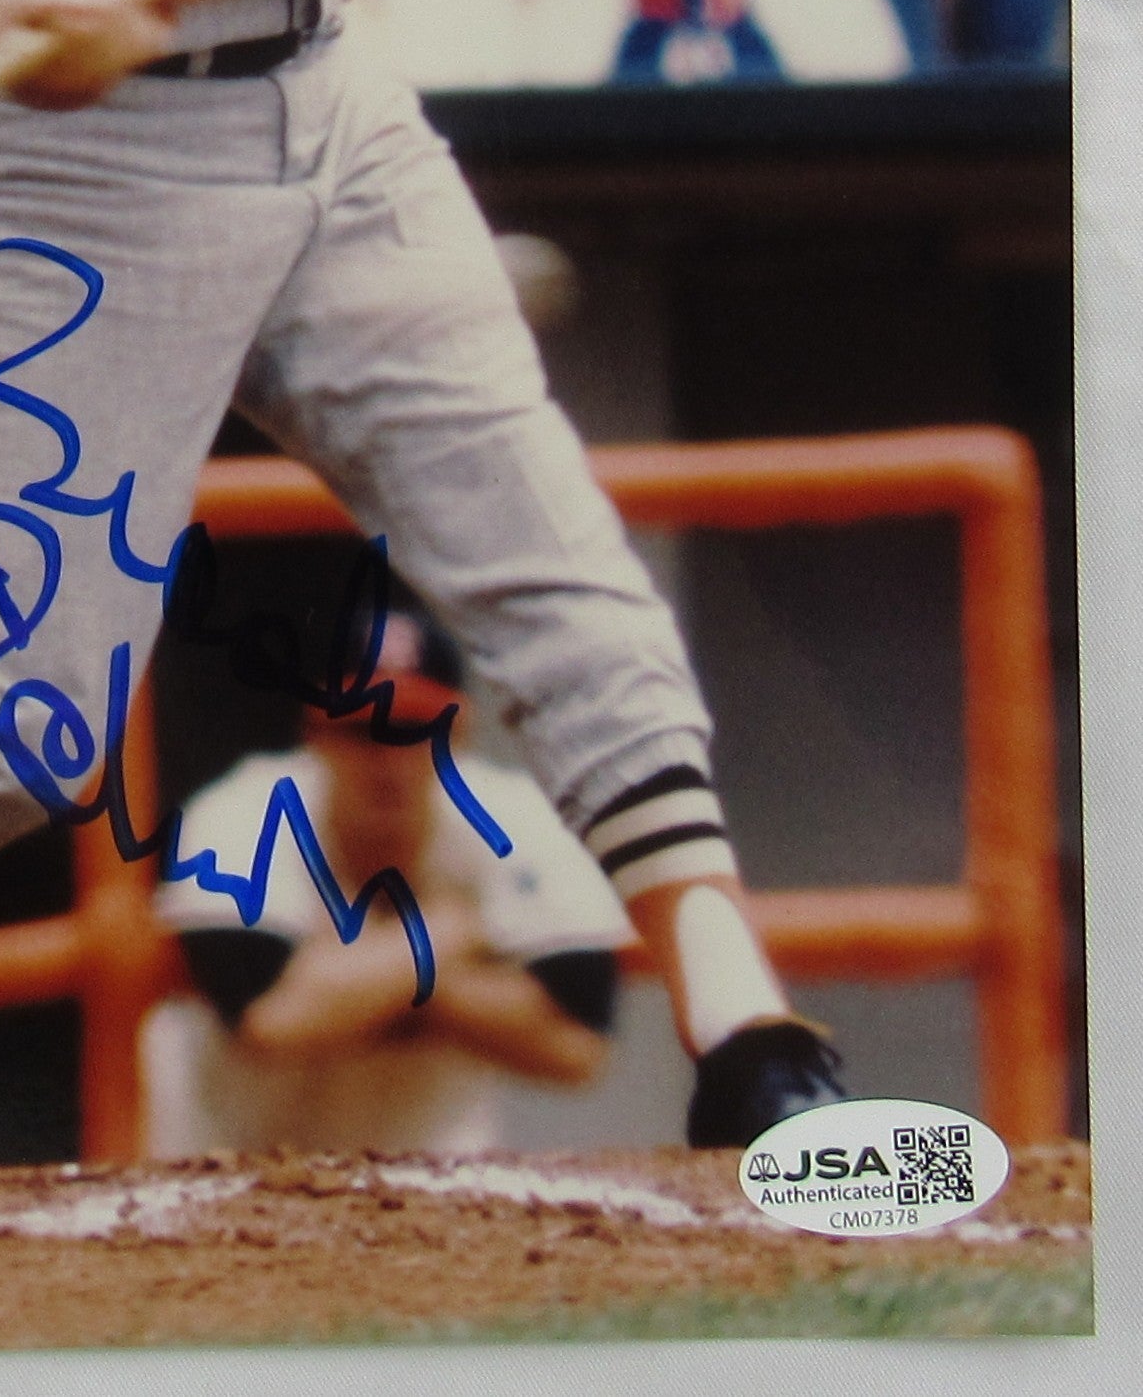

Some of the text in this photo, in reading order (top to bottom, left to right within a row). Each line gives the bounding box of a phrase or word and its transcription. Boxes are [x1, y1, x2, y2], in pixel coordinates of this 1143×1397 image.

[782, 1146, 891, 1182] JSA
[760, 1181, 894, 1205] Authenticated
[829, 1208, 919, 1229] CM07378
